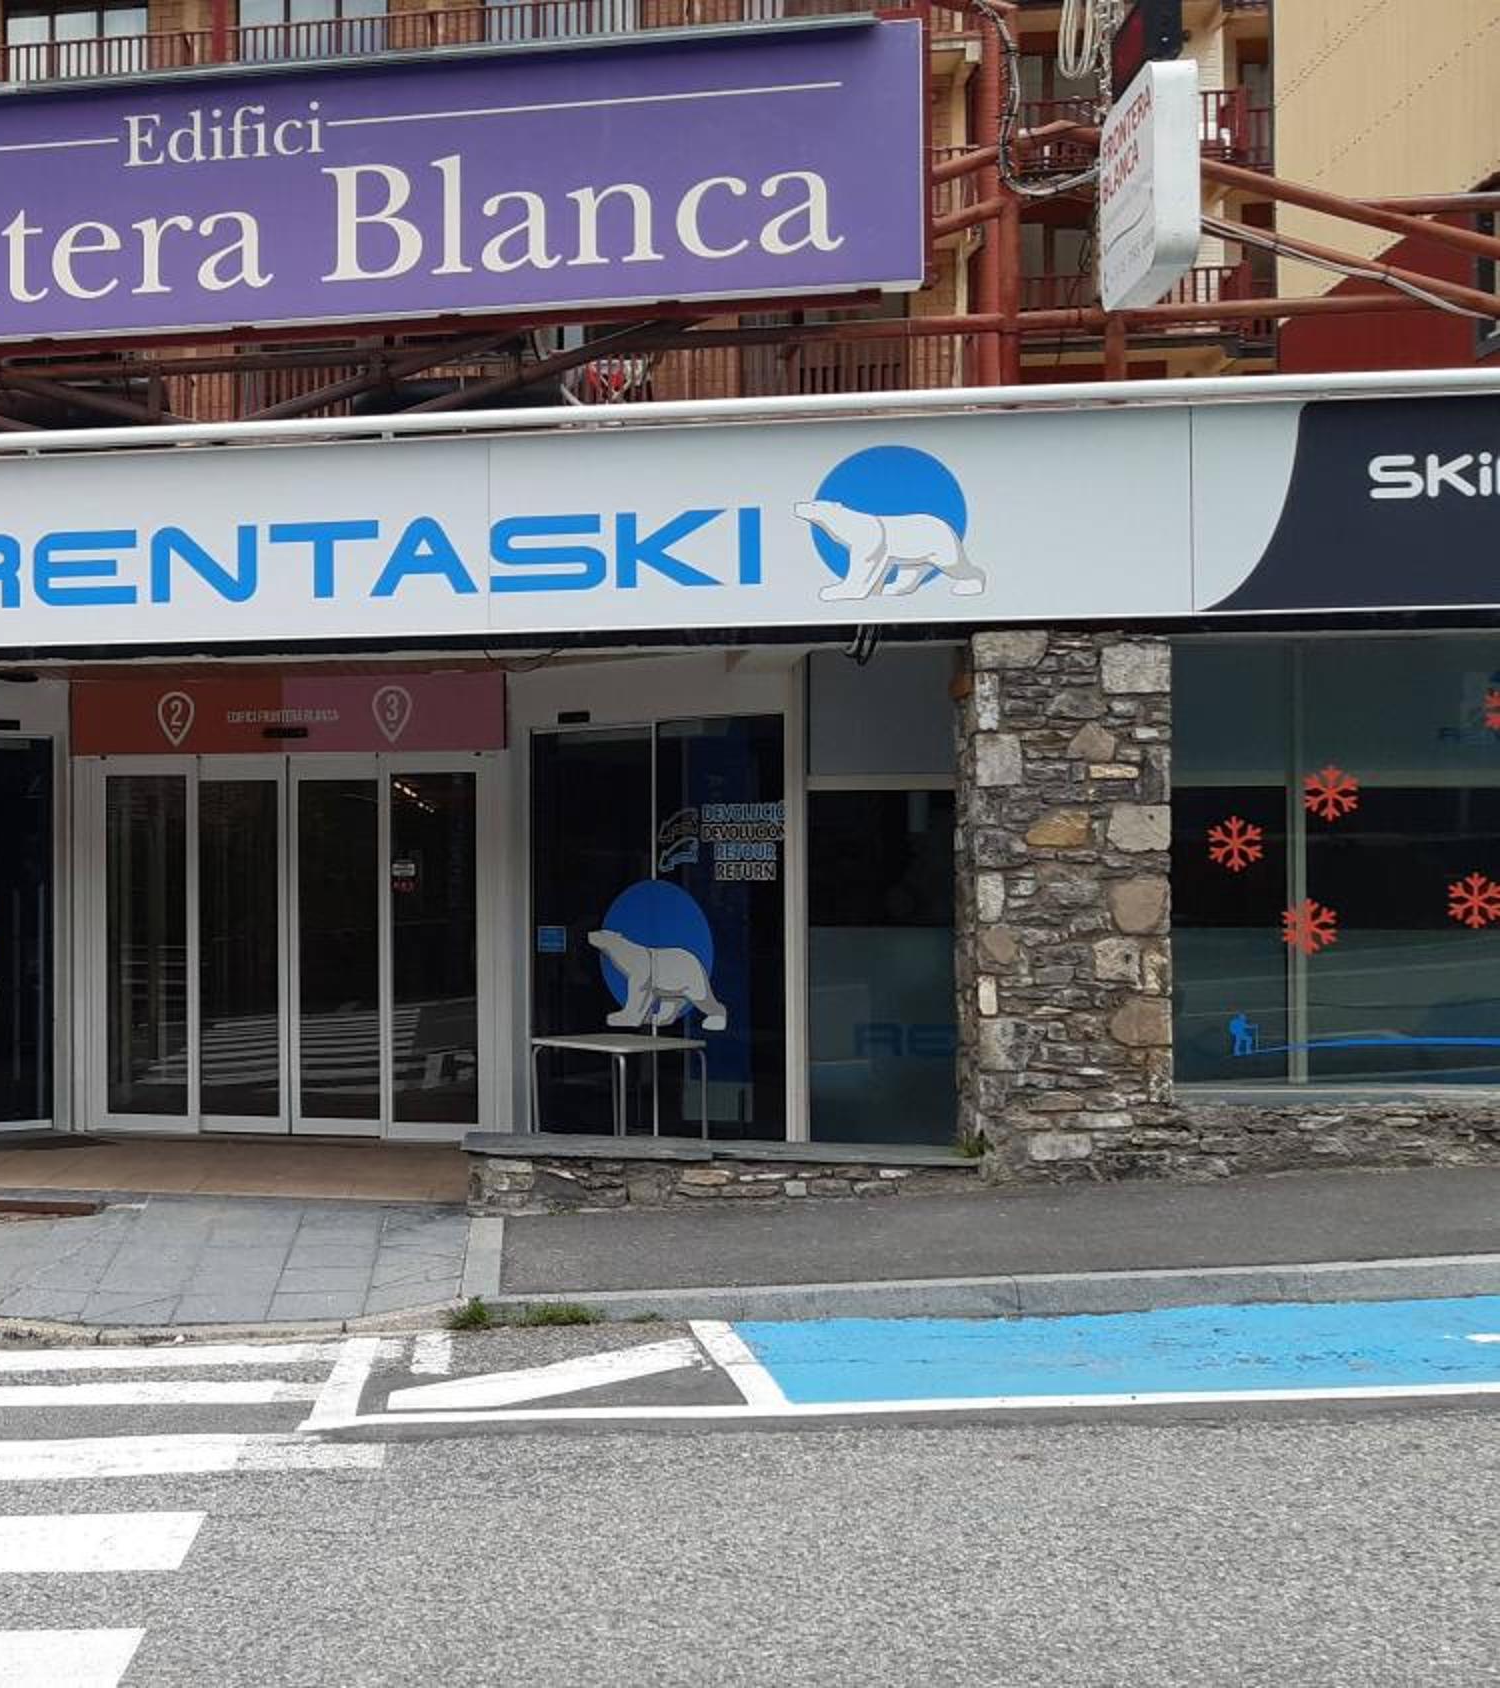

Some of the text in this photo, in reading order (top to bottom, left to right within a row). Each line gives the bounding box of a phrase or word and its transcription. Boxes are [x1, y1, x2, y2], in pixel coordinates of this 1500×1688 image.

[123, 101, 324, 168] Edifici
[1102, 85, 1153, 162] FRONTERA
[321, 154, 845, 284] Blanca
[1367, 451, 1500, 499] SKi
[170, 699, 183, 726] 2
[386, 693, 399, 720] 3
[715, 861, 777, 880] RETURN
